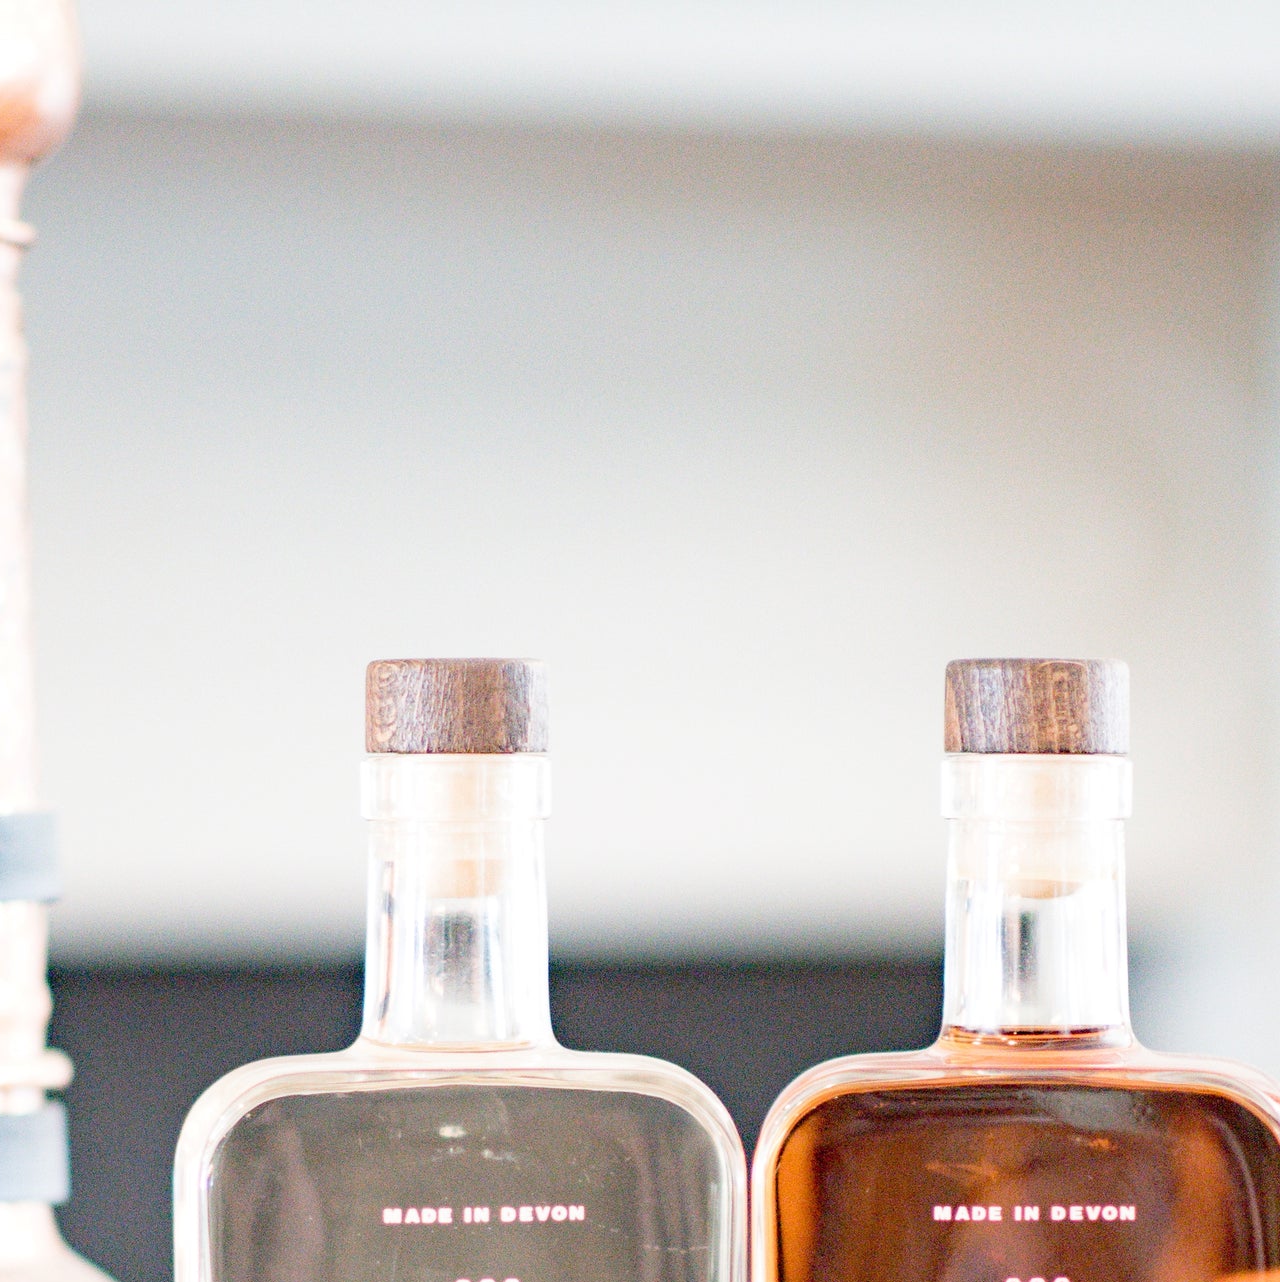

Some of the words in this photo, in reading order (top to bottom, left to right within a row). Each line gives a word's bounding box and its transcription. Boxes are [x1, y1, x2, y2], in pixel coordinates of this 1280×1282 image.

[382, 1207, 453, 1225] MADE
[463, 1206, 491, 1224] IN
[500, 1205, 585, 1223] DEVON
[933, 1205, 1003, 1222] MADE
[1014, 1205, 1040, 1222] IN
[1050, 1205, 1137, 1222] DEVON
